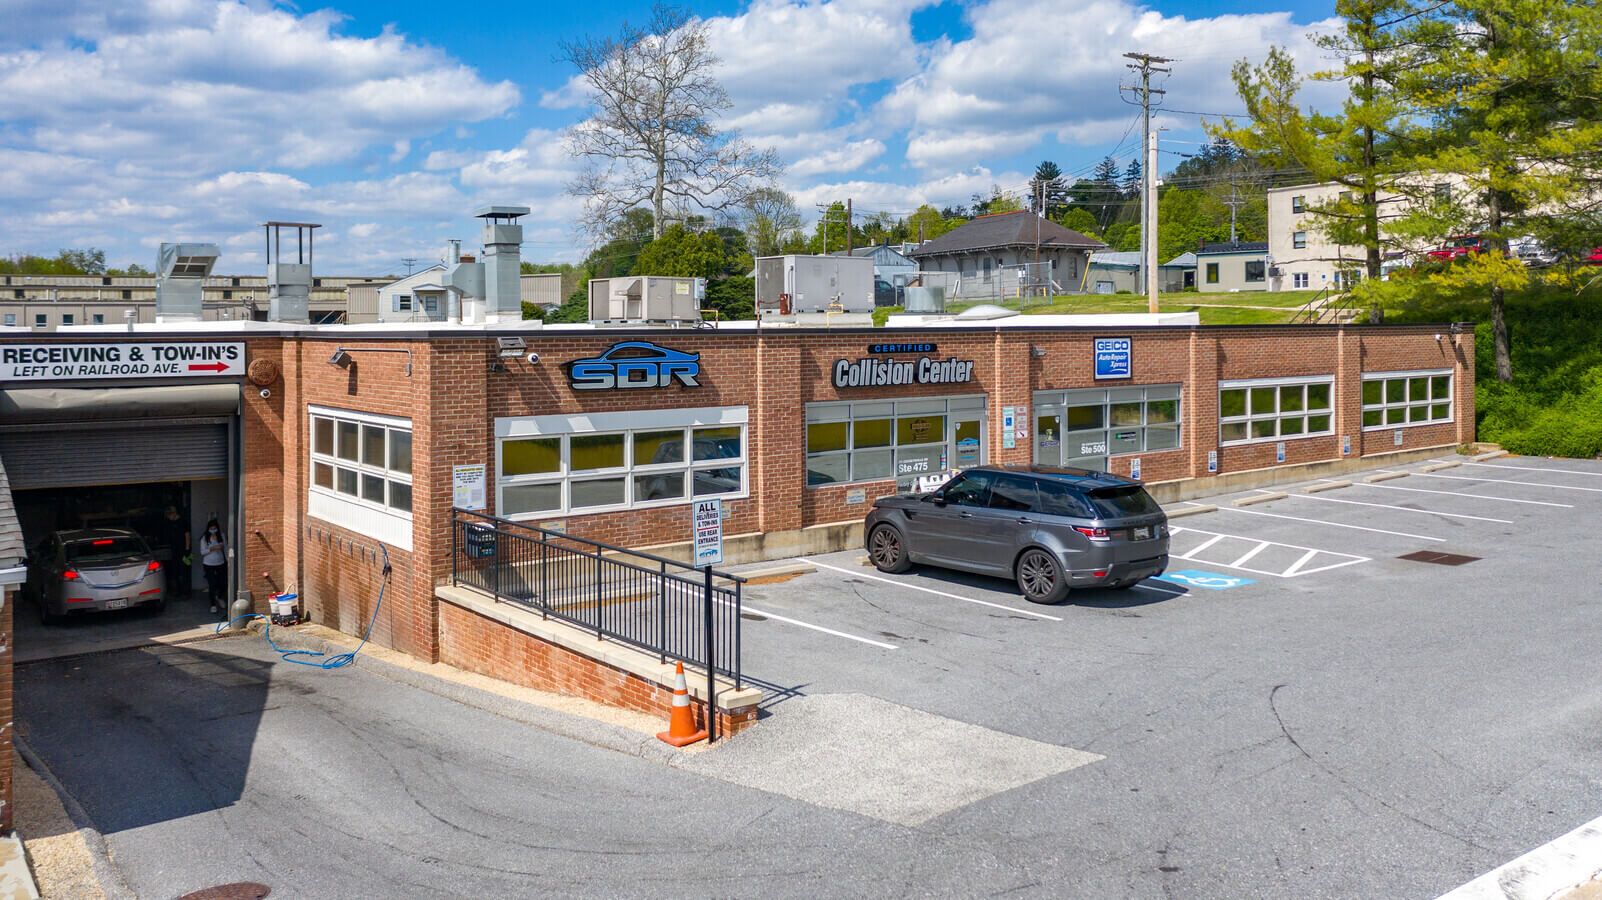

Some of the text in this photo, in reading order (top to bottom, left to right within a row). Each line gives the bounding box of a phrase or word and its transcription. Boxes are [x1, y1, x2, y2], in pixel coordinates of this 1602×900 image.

[874, 344, 932, 353] CERTIFIED
[1097, 341, 1129, 351] GEICO
[3, 345, 239, 364] RECEIVING & TOW-IN'S
[13, 362, 182, 377] LEFT ON RAILROAD AVE.
[835, 357, 974, 388] Collision Center
[570, 361, 701, 390] SDR
[898, 462, 929, 473] Ste 475
[699, 502, 716, 513] ALL
[696, 512, 718, 521] DELIVERIES
[698, 536, 719, 545] ENTRANCE
